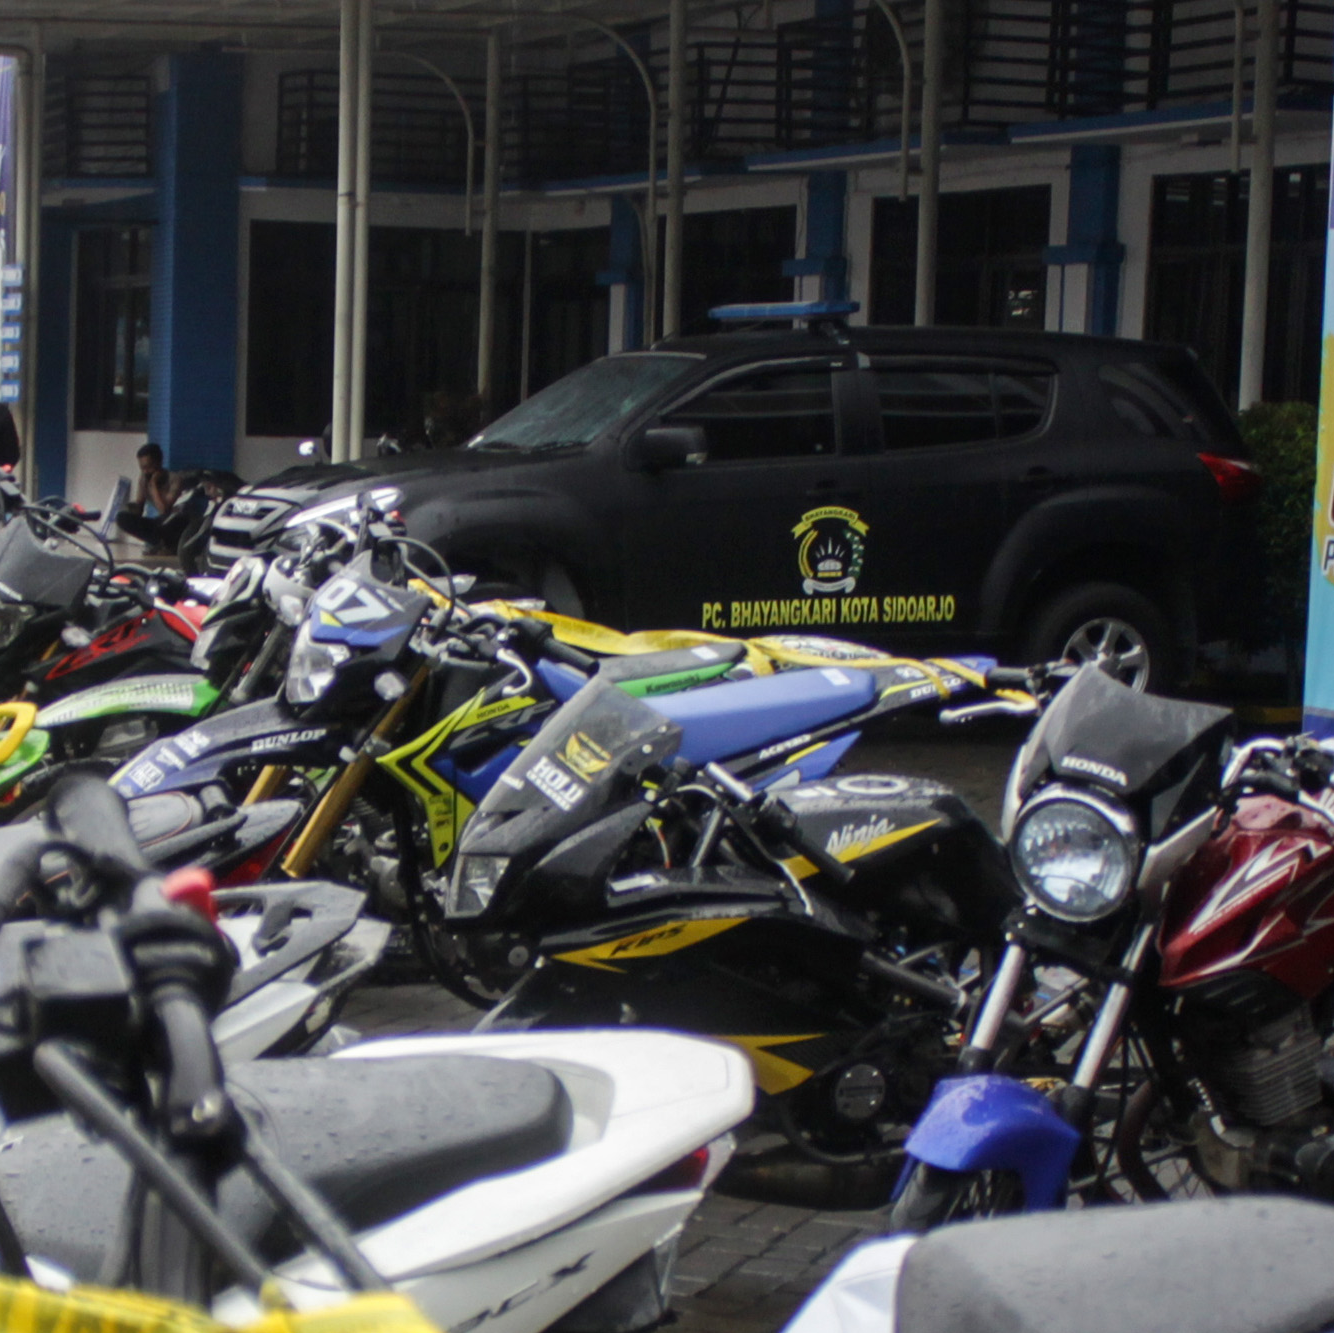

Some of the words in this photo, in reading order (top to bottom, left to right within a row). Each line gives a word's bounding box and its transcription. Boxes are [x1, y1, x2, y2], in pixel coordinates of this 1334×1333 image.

[701, 602, 727, 629] PC.
[730, 598, 837, 628] BHAYANGKARI
[839, 596, 879, 624] KOTA
[882, 594, 956, 622] SIDOARJO
[251, 728, 327, 753] DUNLOP
[1061, 755, 1129, 787] HONDA
[825, 814, 897, 857] Ninja
